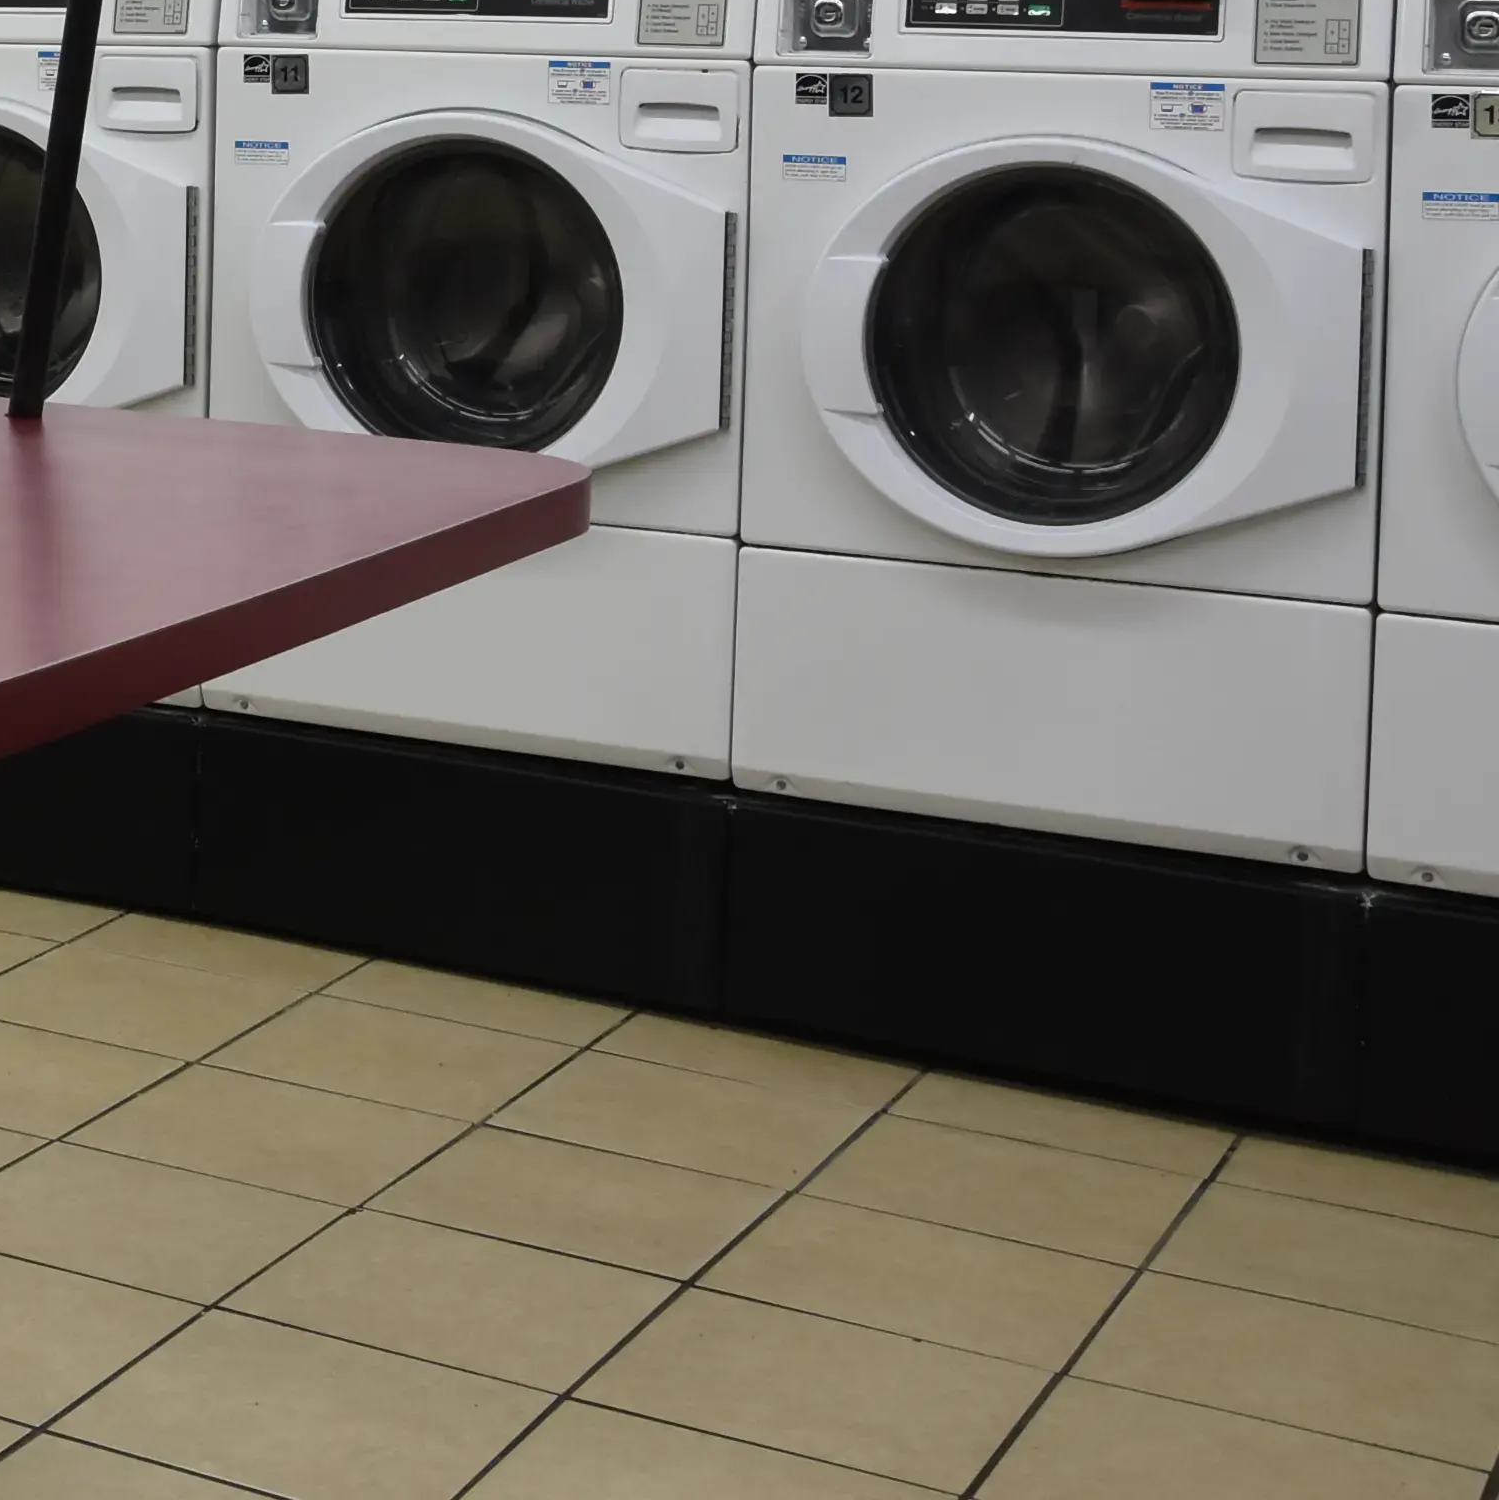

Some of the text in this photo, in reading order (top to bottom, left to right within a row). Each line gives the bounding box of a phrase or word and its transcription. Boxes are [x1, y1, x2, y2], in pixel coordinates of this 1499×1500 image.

[280, 65, 299, 83] 11
[839, 85, 864, 104] 12
[1483, 104, 1499, 125] 1
[791, 155, 838, 163] NOTICE
[1432, 193, 1490, 202] NOTICE
